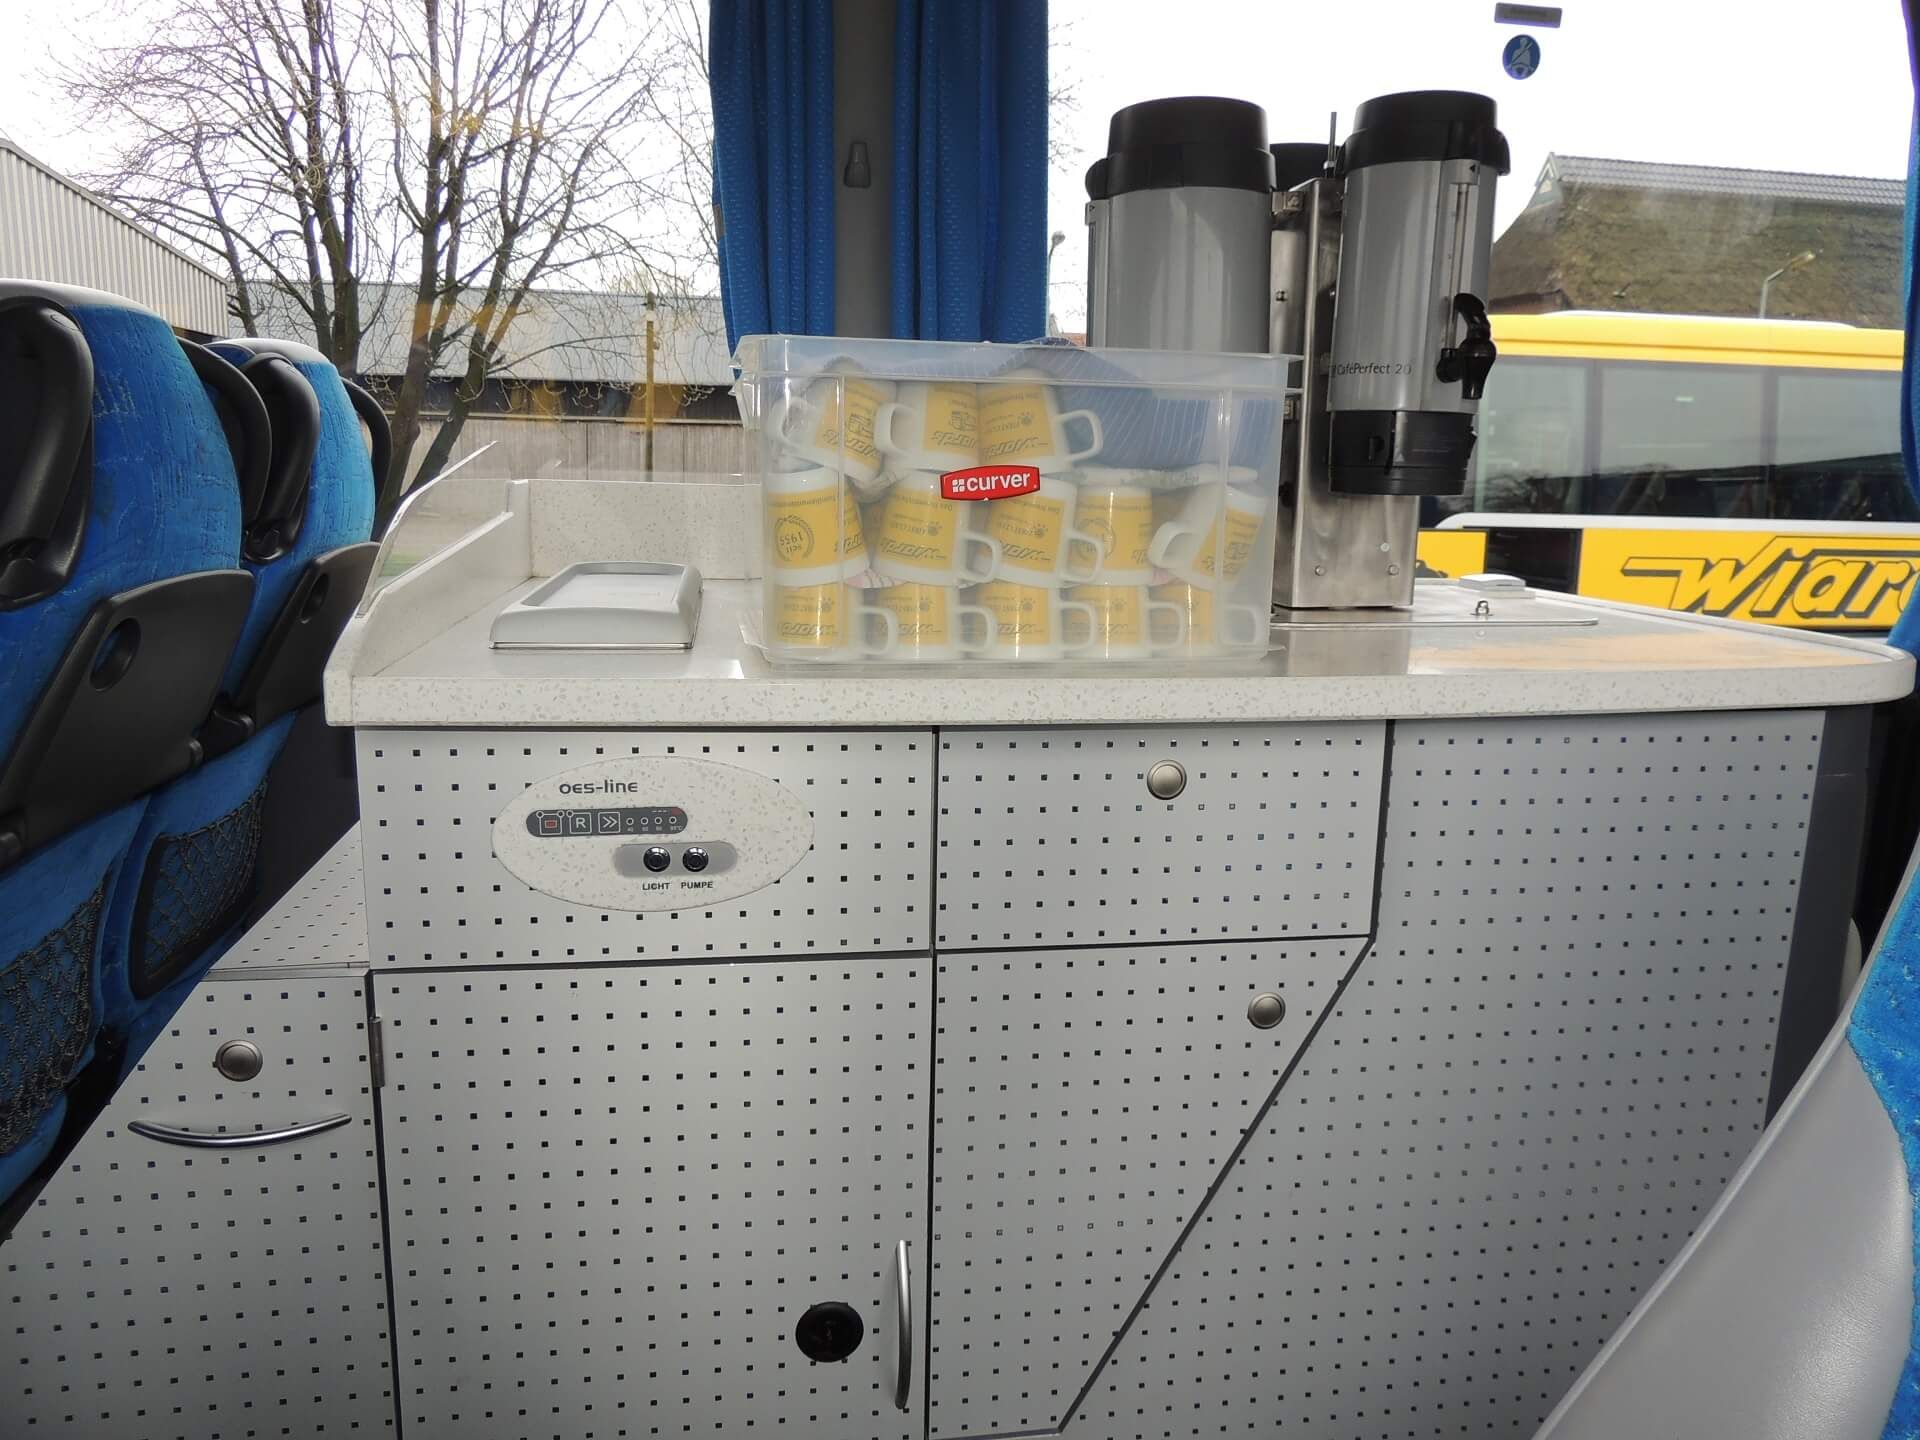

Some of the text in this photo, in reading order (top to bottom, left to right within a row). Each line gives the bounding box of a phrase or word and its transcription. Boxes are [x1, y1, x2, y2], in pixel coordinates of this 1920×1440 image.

[966, 472, 1030, 492] curver
[779, 531, 804, 547] 1955
[1620, 535, 1920, 618] Wiar
[575, 816, 587, 829] R
[642, 881, 714, 891] LIGHT PUMPE
